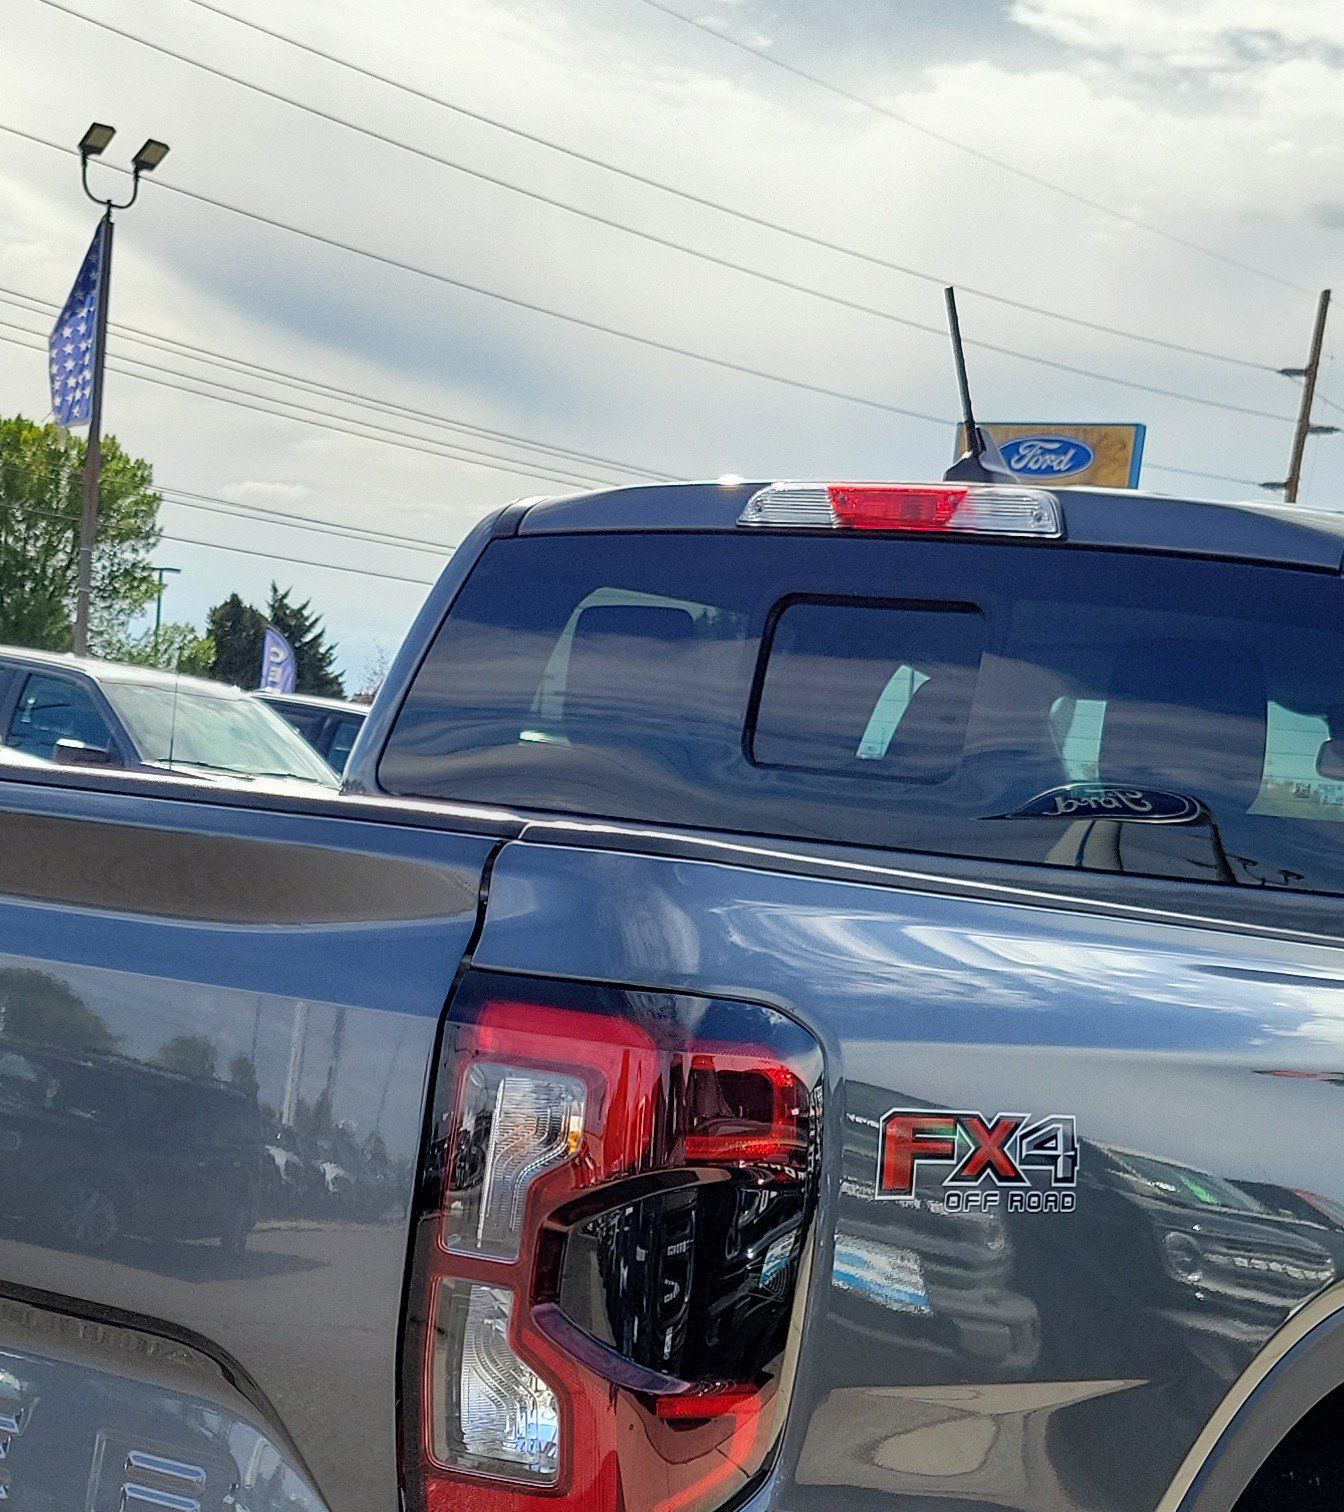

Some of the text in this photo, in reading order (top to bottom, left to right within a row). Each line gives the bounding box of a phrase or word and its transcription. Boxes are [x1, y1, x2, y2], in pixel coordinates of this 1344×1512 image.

[1010, 440, 1074, 472] Ford
[874, 1107, 1080, 1201] FX4
[944, 1190, 1077, 1214] OFF ROAD
